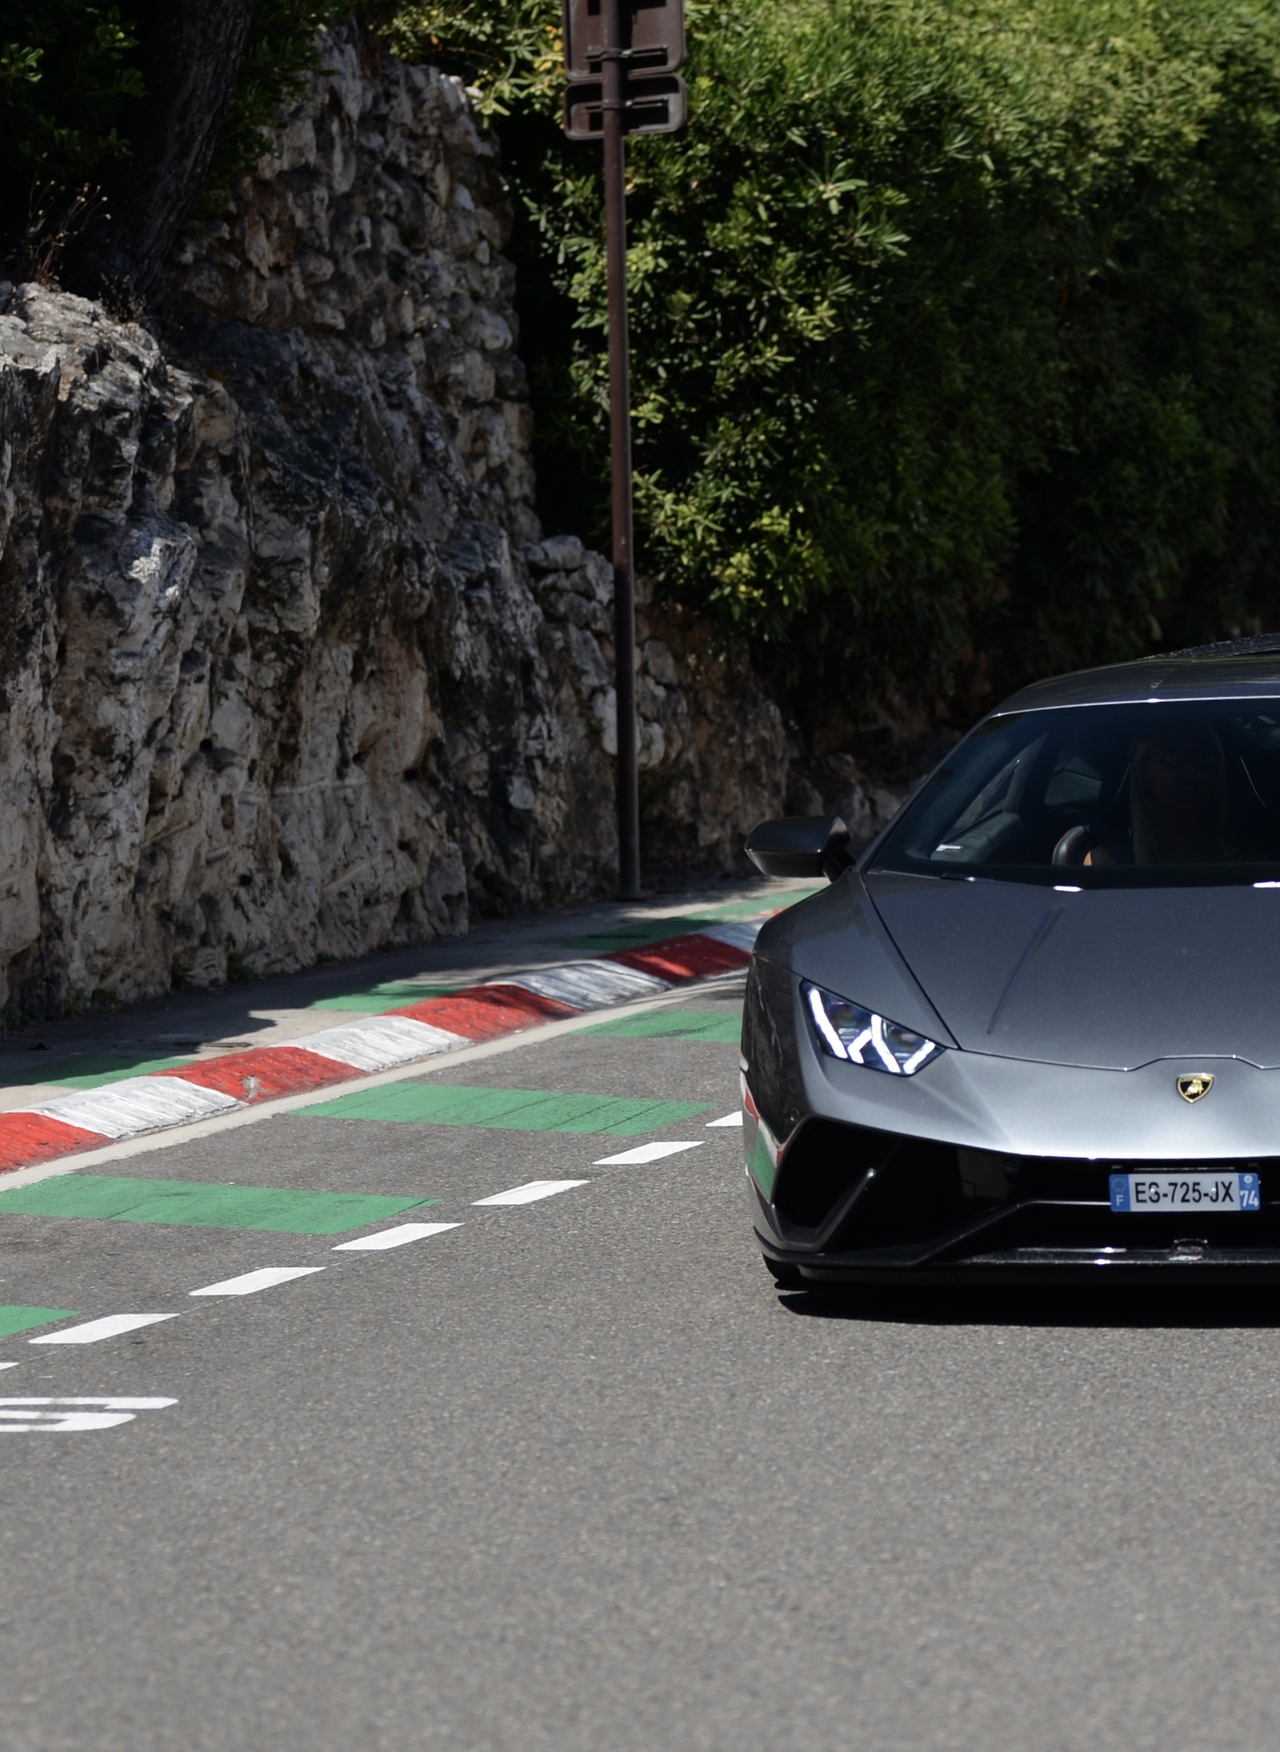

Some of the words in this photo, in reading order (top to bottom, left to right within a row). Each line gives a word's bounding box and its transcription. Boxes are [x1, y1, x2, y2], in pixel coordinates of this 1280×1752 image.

[1116, 1195, 1124, 1207] F
[1134, 1181, 1235, 1204] ES-725-JX
[1239, 1190, 1260, 1208] 74
